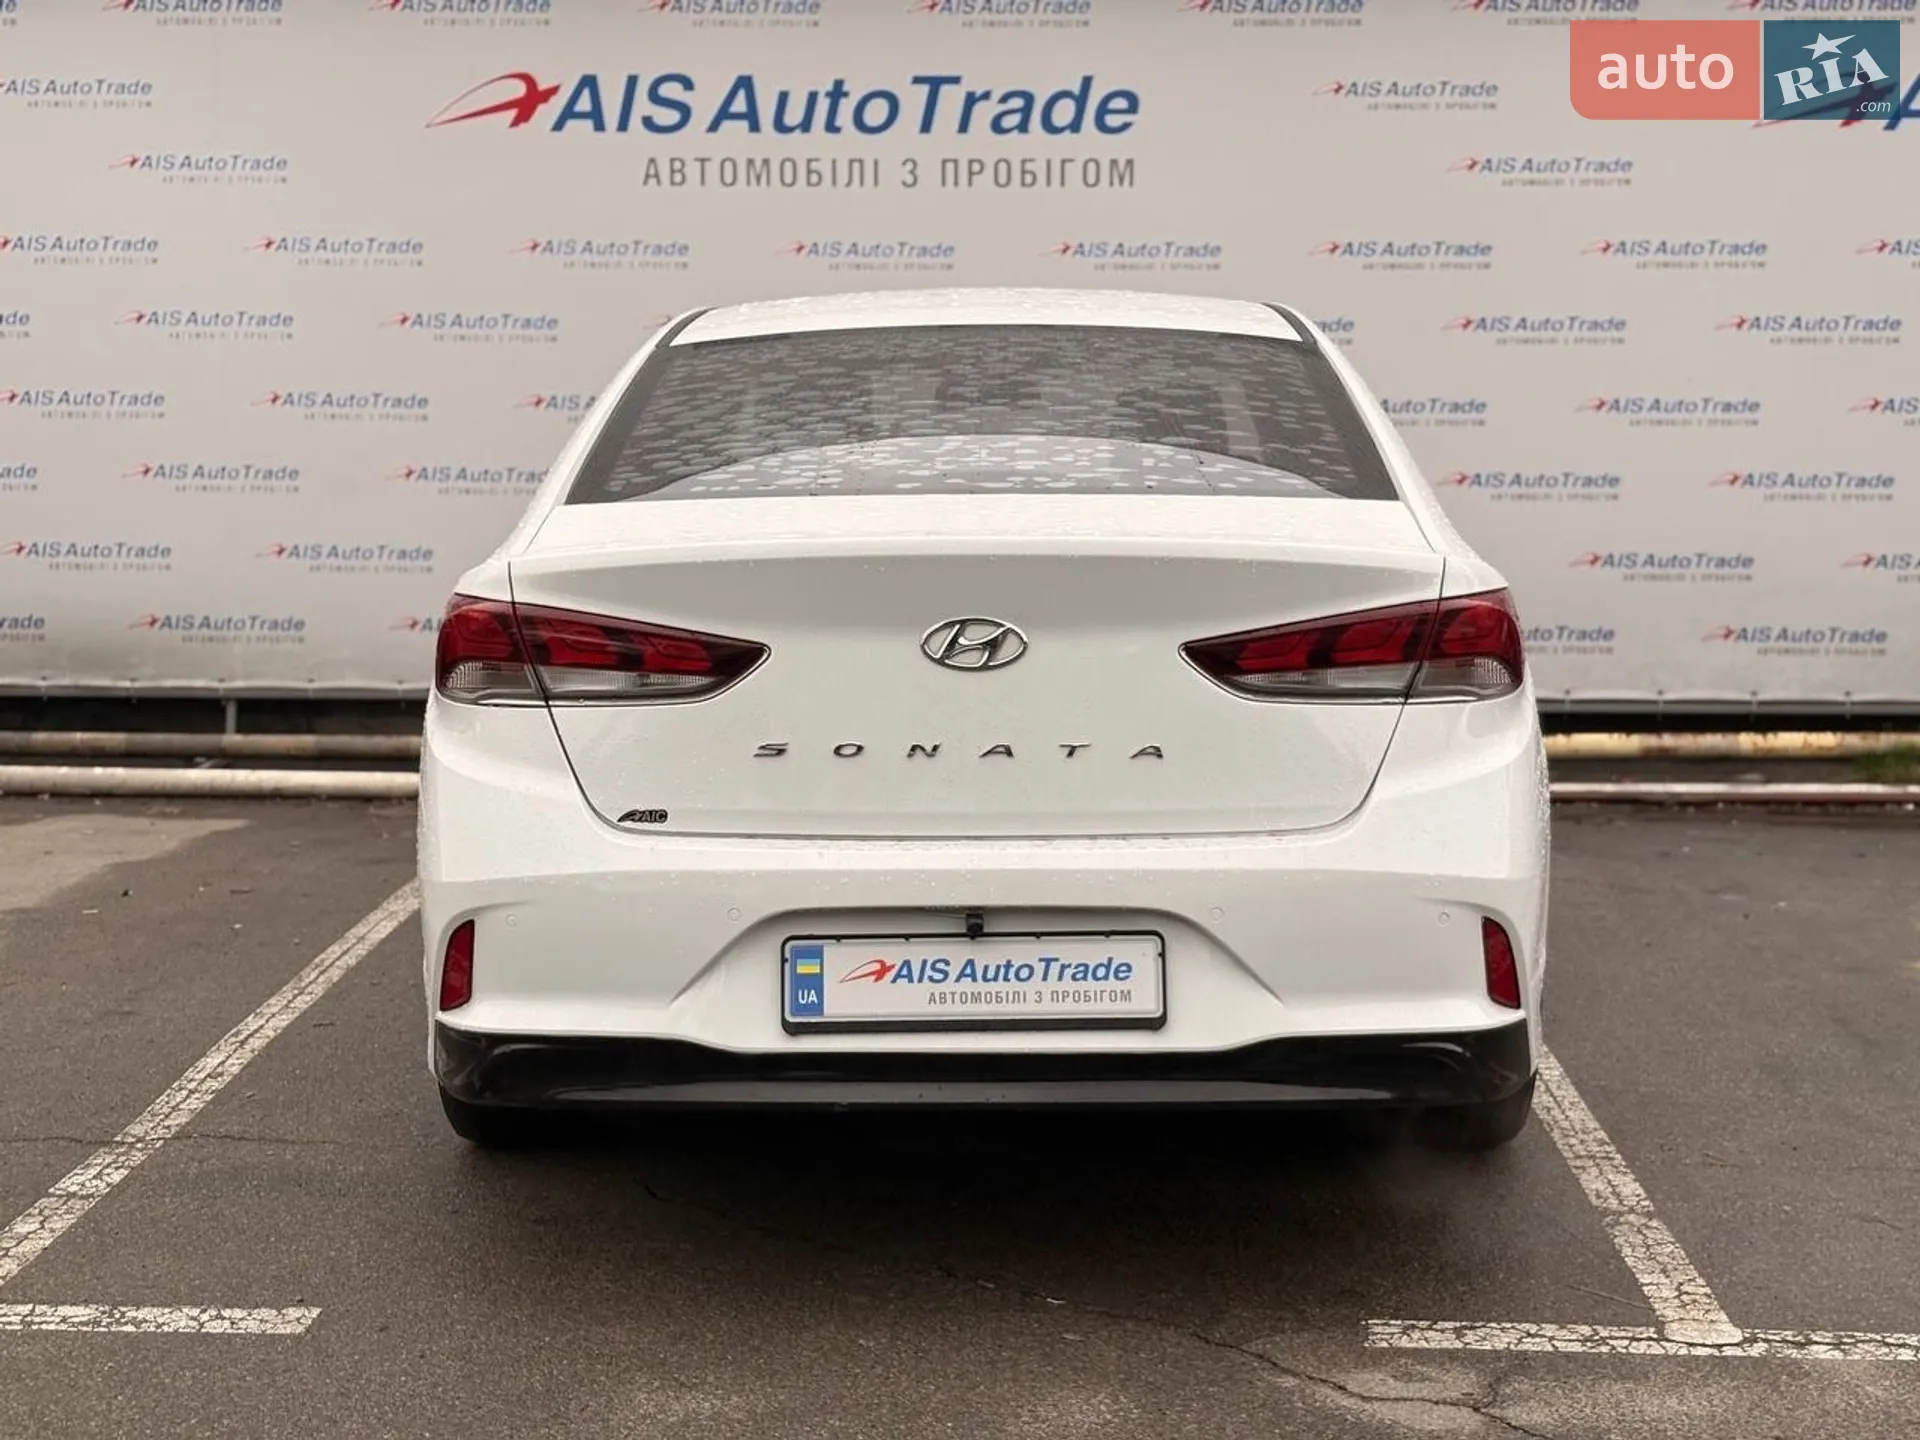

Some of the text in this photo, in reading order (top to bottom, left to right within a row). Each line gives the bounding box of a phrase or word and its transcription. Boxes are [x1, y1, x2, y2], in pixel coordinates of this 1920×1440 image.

[4, 79, 40, 96] AIS
[1344, 81, 1381, 97] AIS
[550, 73, 695, 134] AIS
[140, 155, 175, 171] AIS
[1479, 157, 1516, 174] AIS
[642, 157, 1136, 188] АВТОМОБІЛІ З ПРОБІГОМ
[11, 236, 47, 252] AIS
[275, 238, 311, 254] AIS
[540, 240, 577, 256] AIS
[806, 242, 841, 258] AIS
[1071, 242, 1109, 258] AIS
[1338, 241, 1377, 258] AIS
[1612, 240, 1650, 256] AIS
[147, 311, 181, 327] AIS
[411, 314, 446, 331] AIS
[1473, 316, 1510, 332] AIS
[1747, 315, 1784, 332] AIS
[18, 390, 54, 407] AIS
[280, 392, 316, 409] AIS
[1605, 398, 1643, 415] AIS
[1882, 397, 1919, 415] AIS
[153, 464, 188, 481] AIS
[416, 466, 450, 482] AIS
[1468, 472, 1505, 489] AIS
[1741, 472, 1777, 489] AIS
[26, 541, 62, 558] AIS
[286, 544, 323, 561] AIS
[1600, 552, 1638, 570] AIS
[1875, 553, 1910, 570] AIS
[159, 614, 195, 631] AIS
[1734, 627, 1772, 644] AIS
[754, 742, 1164, 759] SONATA
[890, 958, 951, 984] AIS
[798, 989, 818, 1004] UA
[928, 990, 1027, 1005] АВТОМОБІЛІ
[1050, 988, 1132, 1003] ПРОБІГОМ
